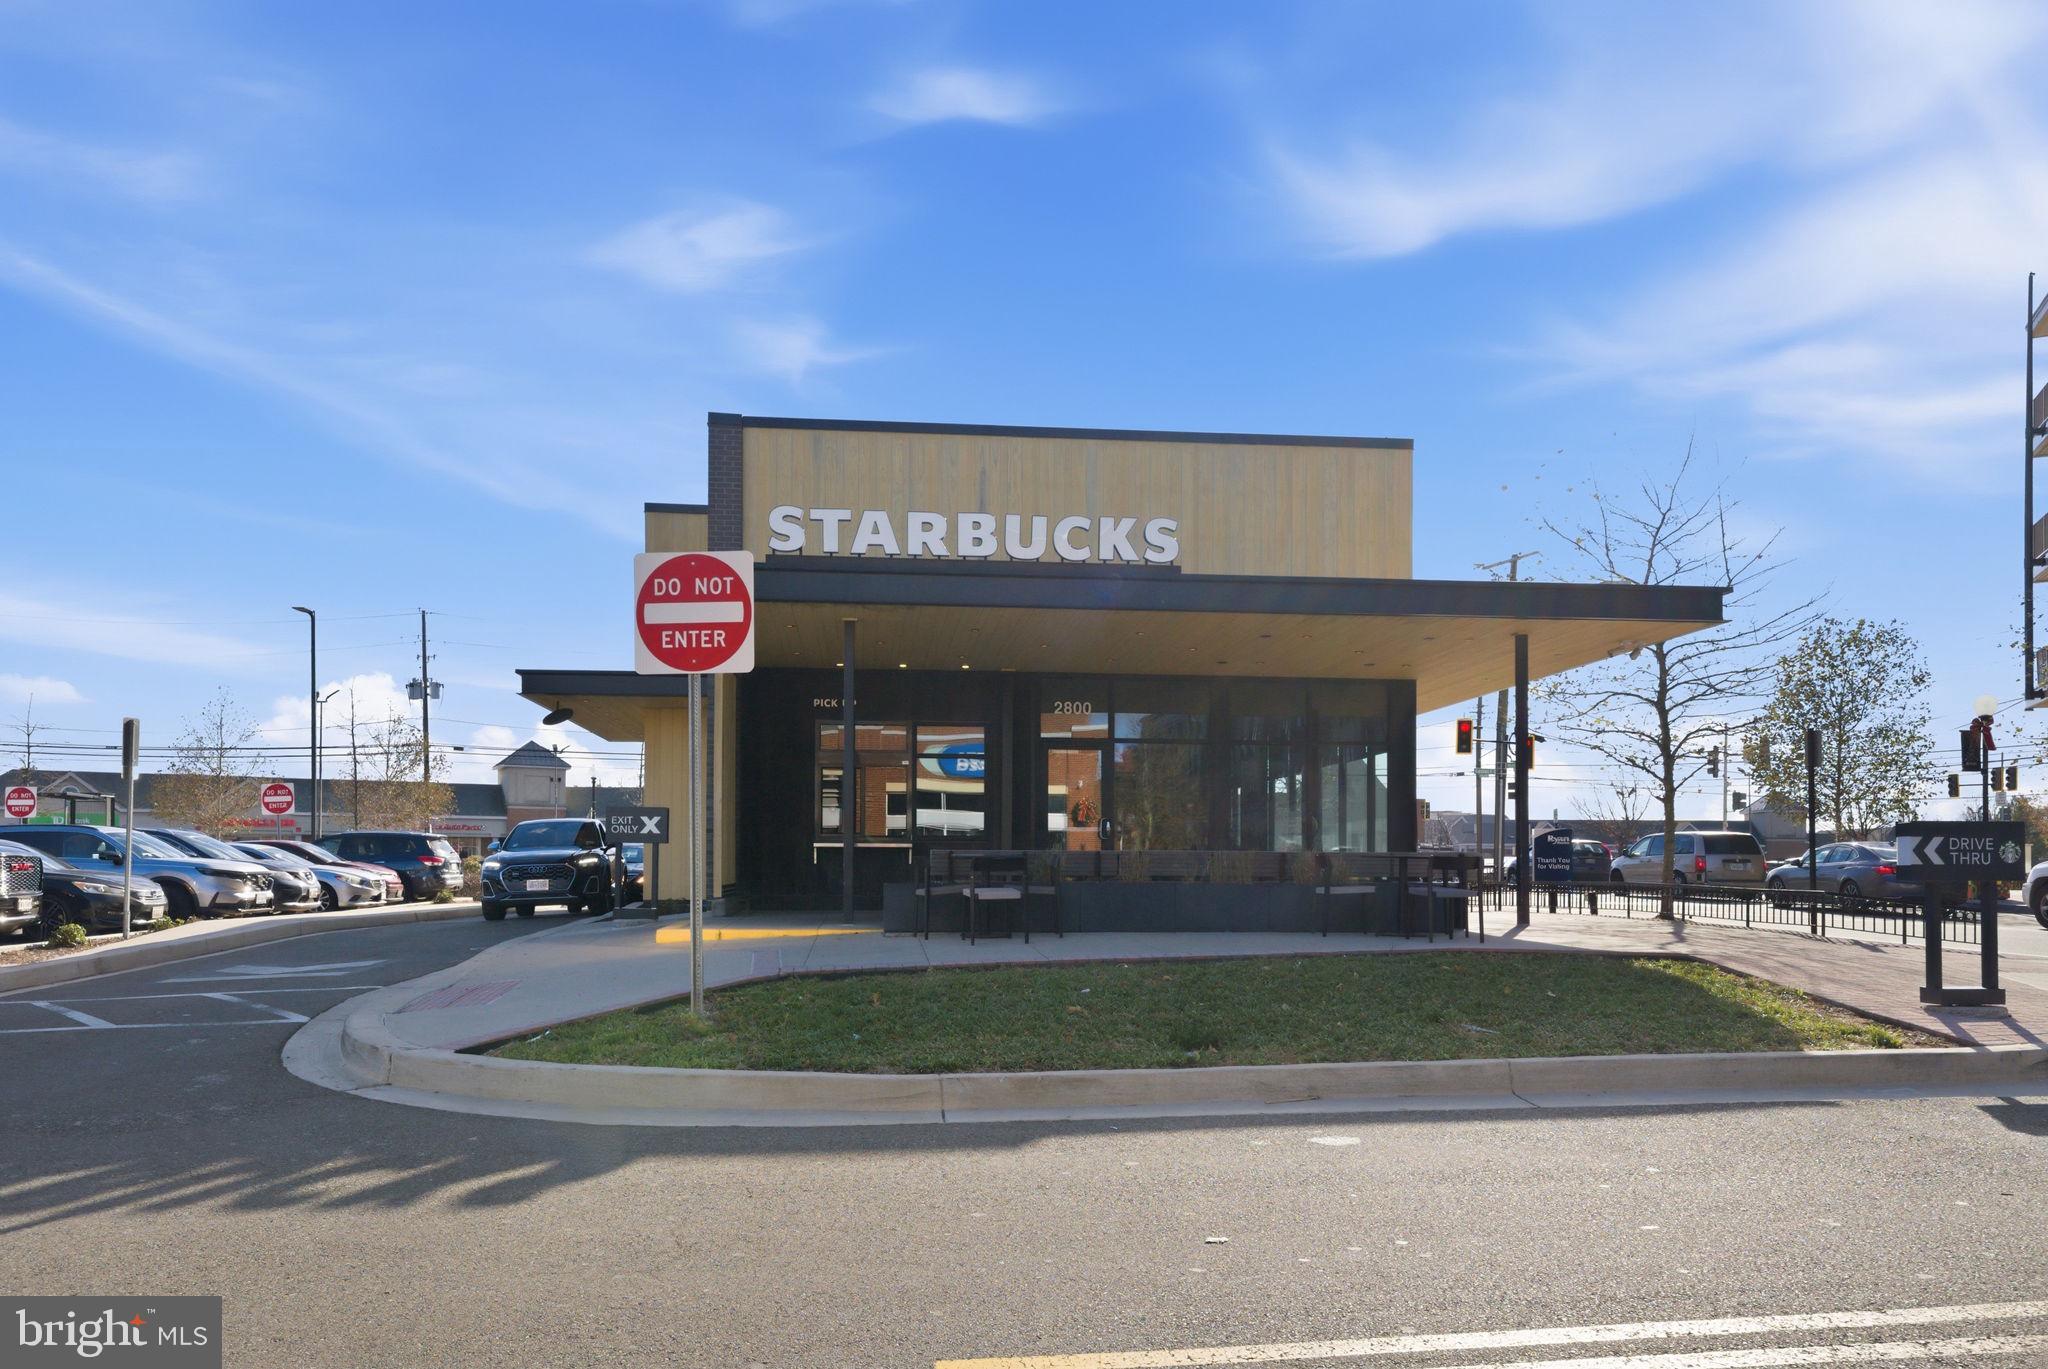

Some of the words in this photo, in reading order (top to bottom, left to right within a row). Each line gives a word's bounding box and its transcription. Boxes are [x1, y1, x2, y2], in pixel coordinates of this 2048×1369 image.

[768, 505, 1180, 564] STARBUCKS
[654, 578, 681, 596] DO
[695, 577, 734, 595] NOT
[661, 630, 726, 649] ENTER
[813, 698, 838, 708] PICK
[1054, 701, 1091, 715] 2800
[611, 816, 633, 824] EXIT
[611, 825, 638, 833] ONLY
[1547, 835, 1569, 844] Ryan
[1949, 838, 1994, 850] DRIVE
[1950, 852, 1991, 865] THRU
